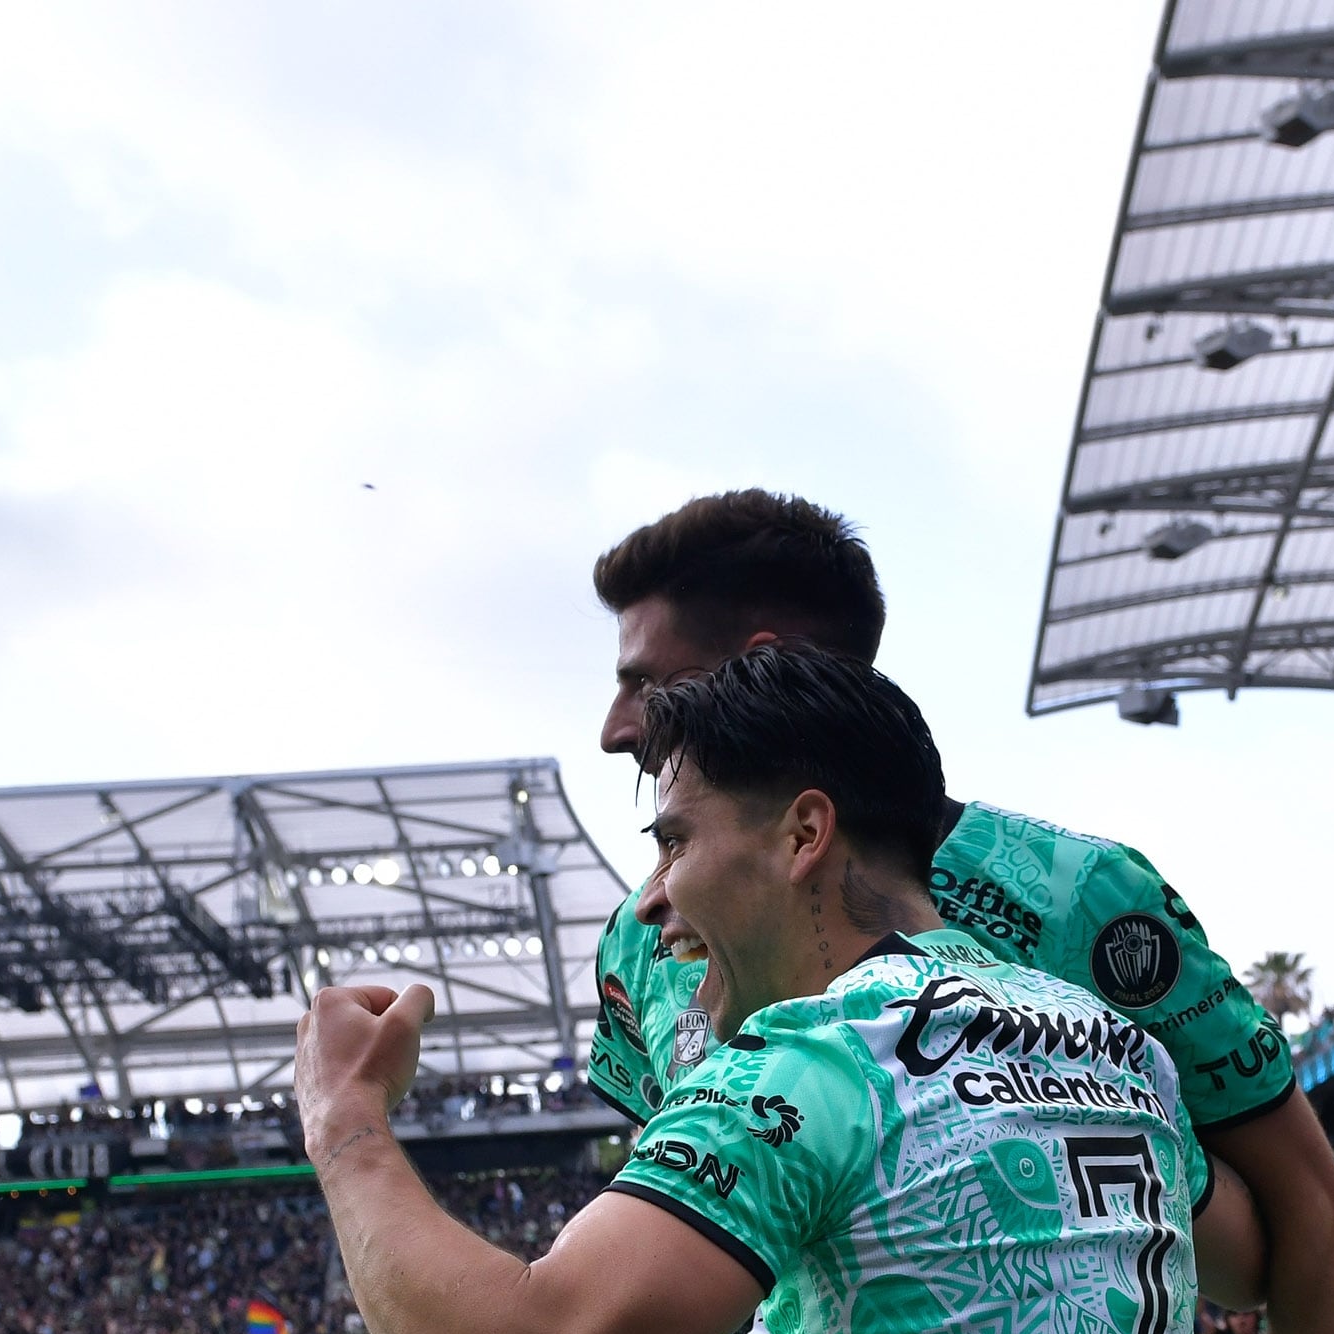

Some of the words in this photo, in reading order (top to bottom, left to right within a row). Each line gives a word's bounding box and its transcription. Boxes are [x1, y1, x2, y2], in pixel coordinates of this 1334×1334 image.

[927, 866, 1042, 938] Office
[931, 896, 1039, 954] EPOT
[923, 944, 992, 965] HARLY
